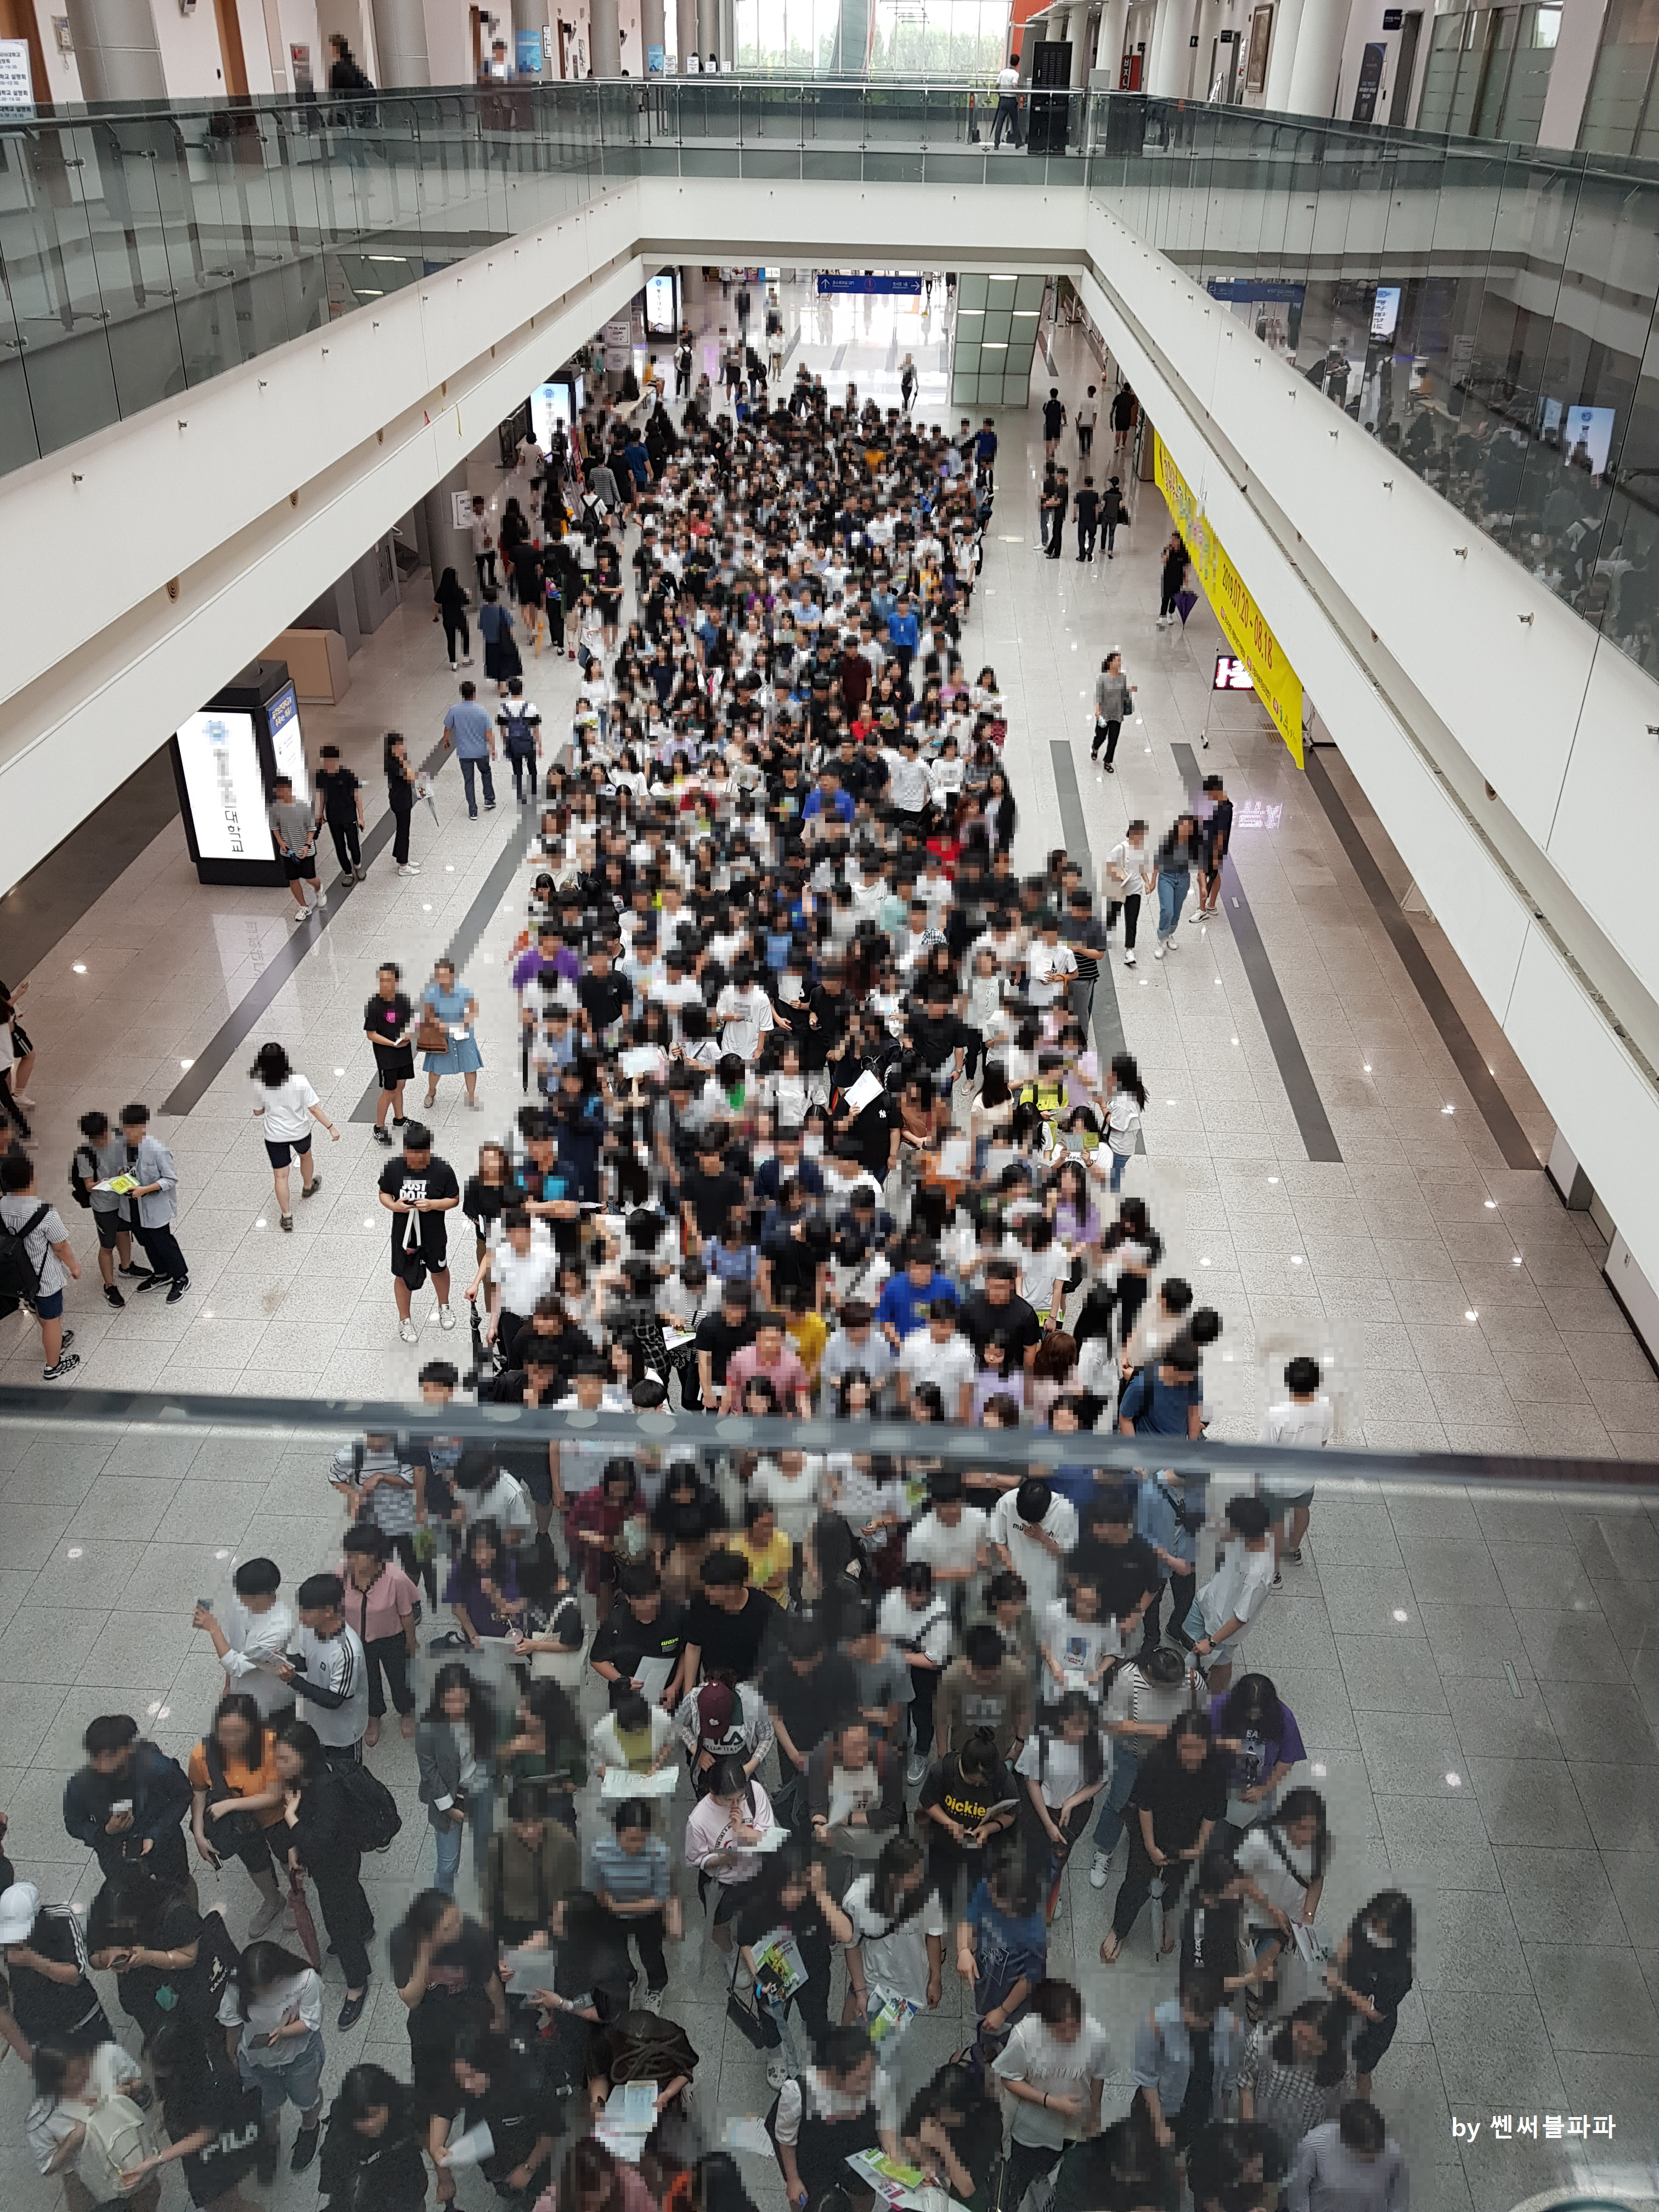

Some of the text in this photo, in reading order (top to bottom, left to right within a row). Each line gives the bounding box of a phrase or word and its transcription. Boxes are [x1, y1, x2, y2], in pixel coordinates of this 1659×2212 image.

[1122, 58, 1132, 91] 비지니
[1223, 563, 1249, 629] 2019.07.20
[1254, 614, 1272, 670] 08.18
[945, 1795, 986, 1817] Dickie
